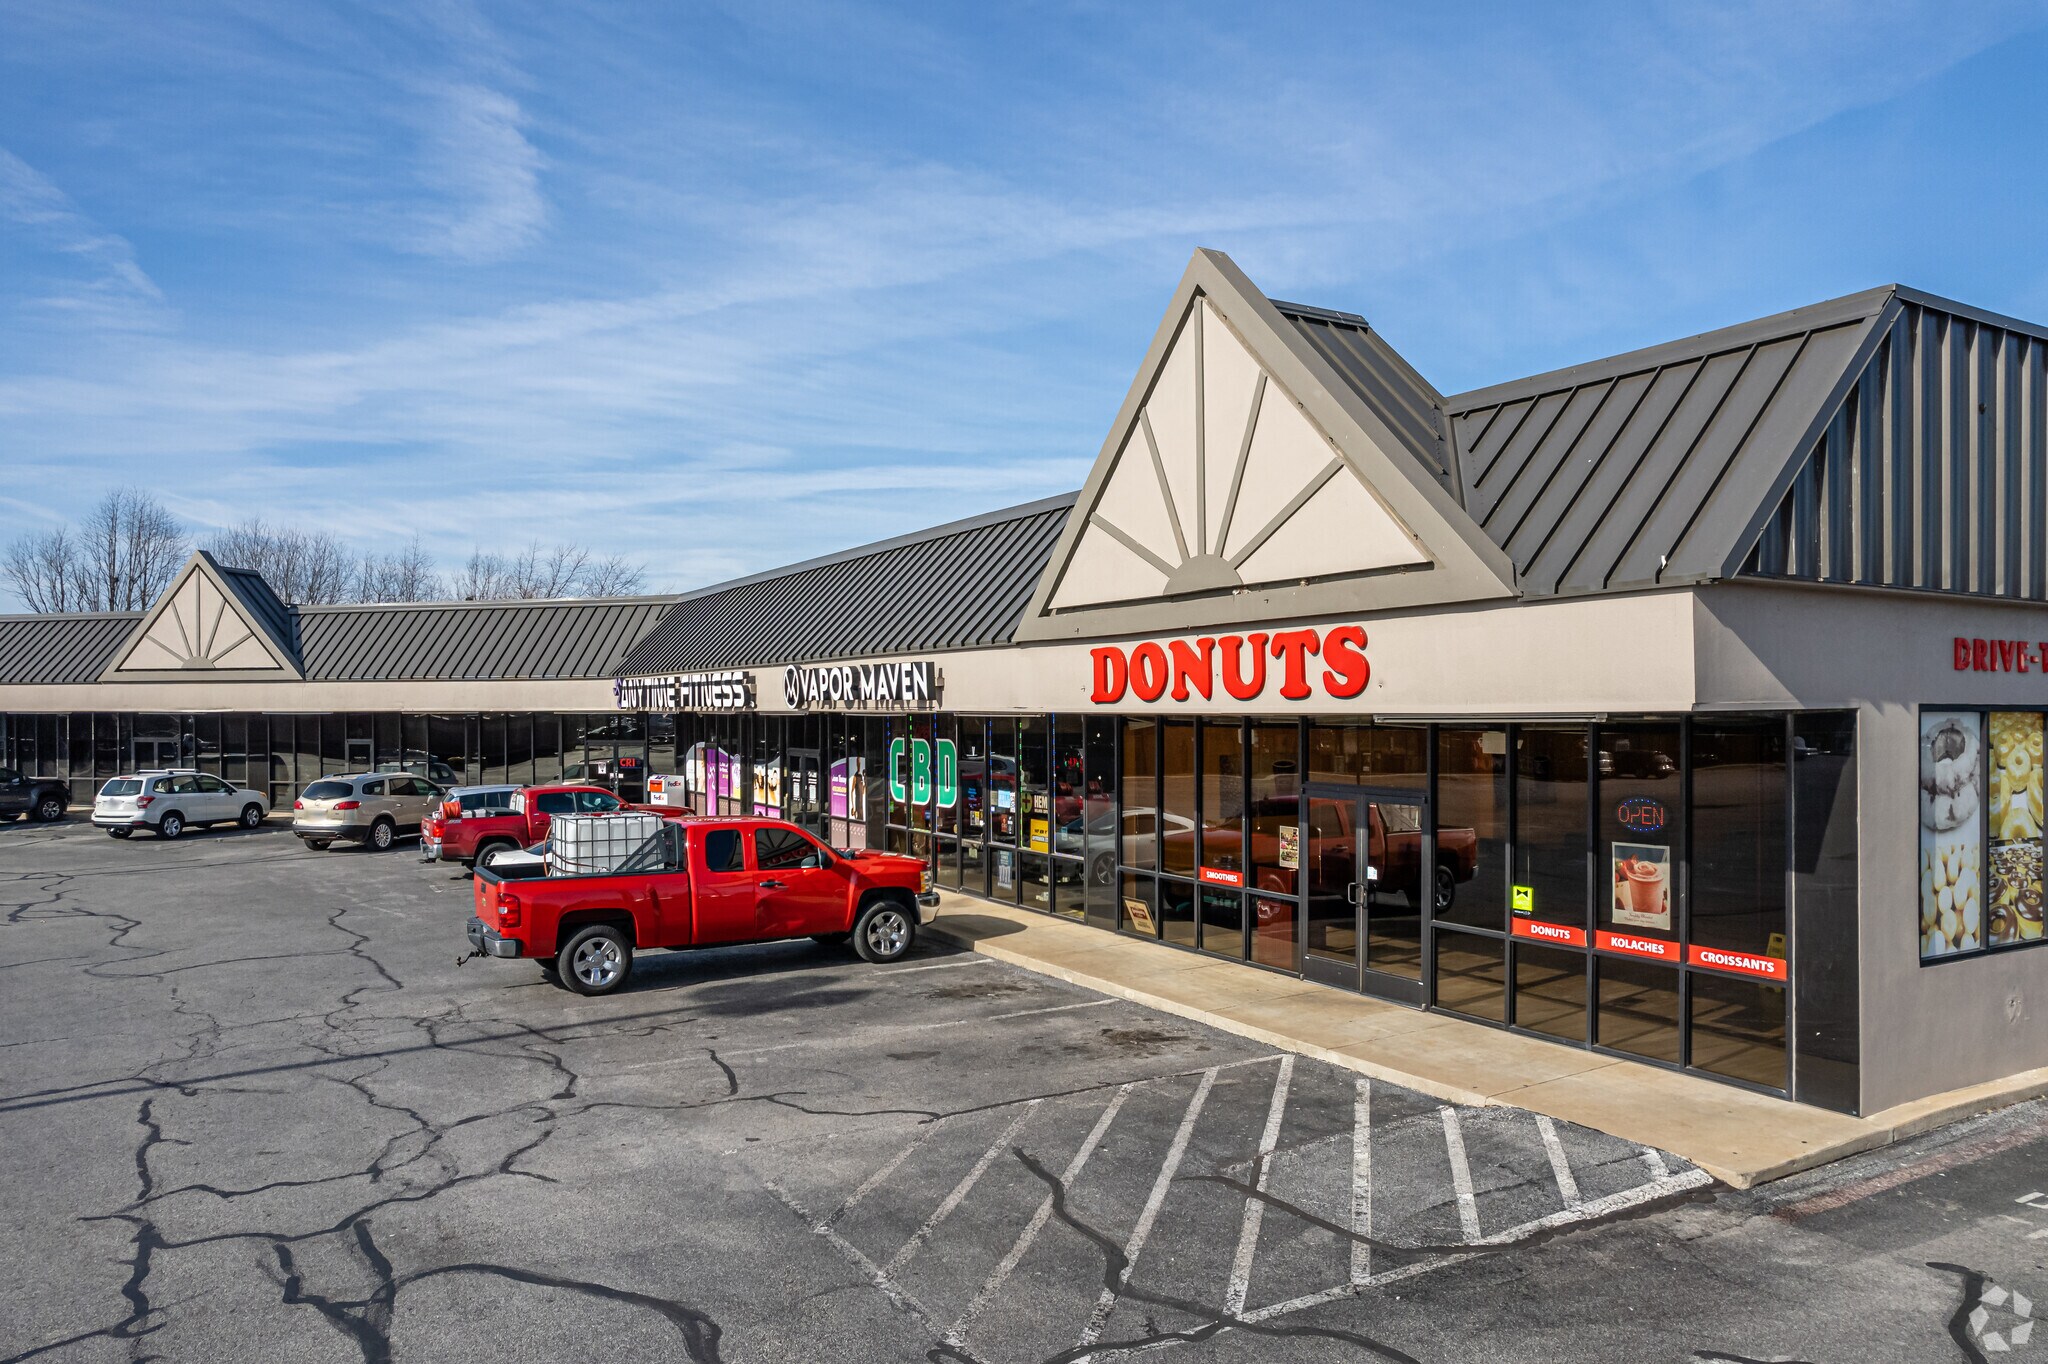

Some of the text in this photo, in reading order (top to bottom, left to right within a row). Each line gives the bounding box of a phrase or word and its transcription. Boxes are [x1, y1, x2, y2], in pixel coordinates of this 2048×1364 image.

[1090, 626, 1371, 703] DONUTS
[620, 671, 745, 708] ANYTIME FITNESS
[799, 662, 928, 701] VAPOR MAVEN
[890, 737, 957, 808] CBD
[1618, 804, 1665, 826] OPEN
[1206, 870, 1238, 882] SMOOTHIES
[1530, 924, 1571, 939] DONUTS
[1610, 936, 1665, 955] KOLACHES
[1700, 951, 1775, 973] CROISSANTS
